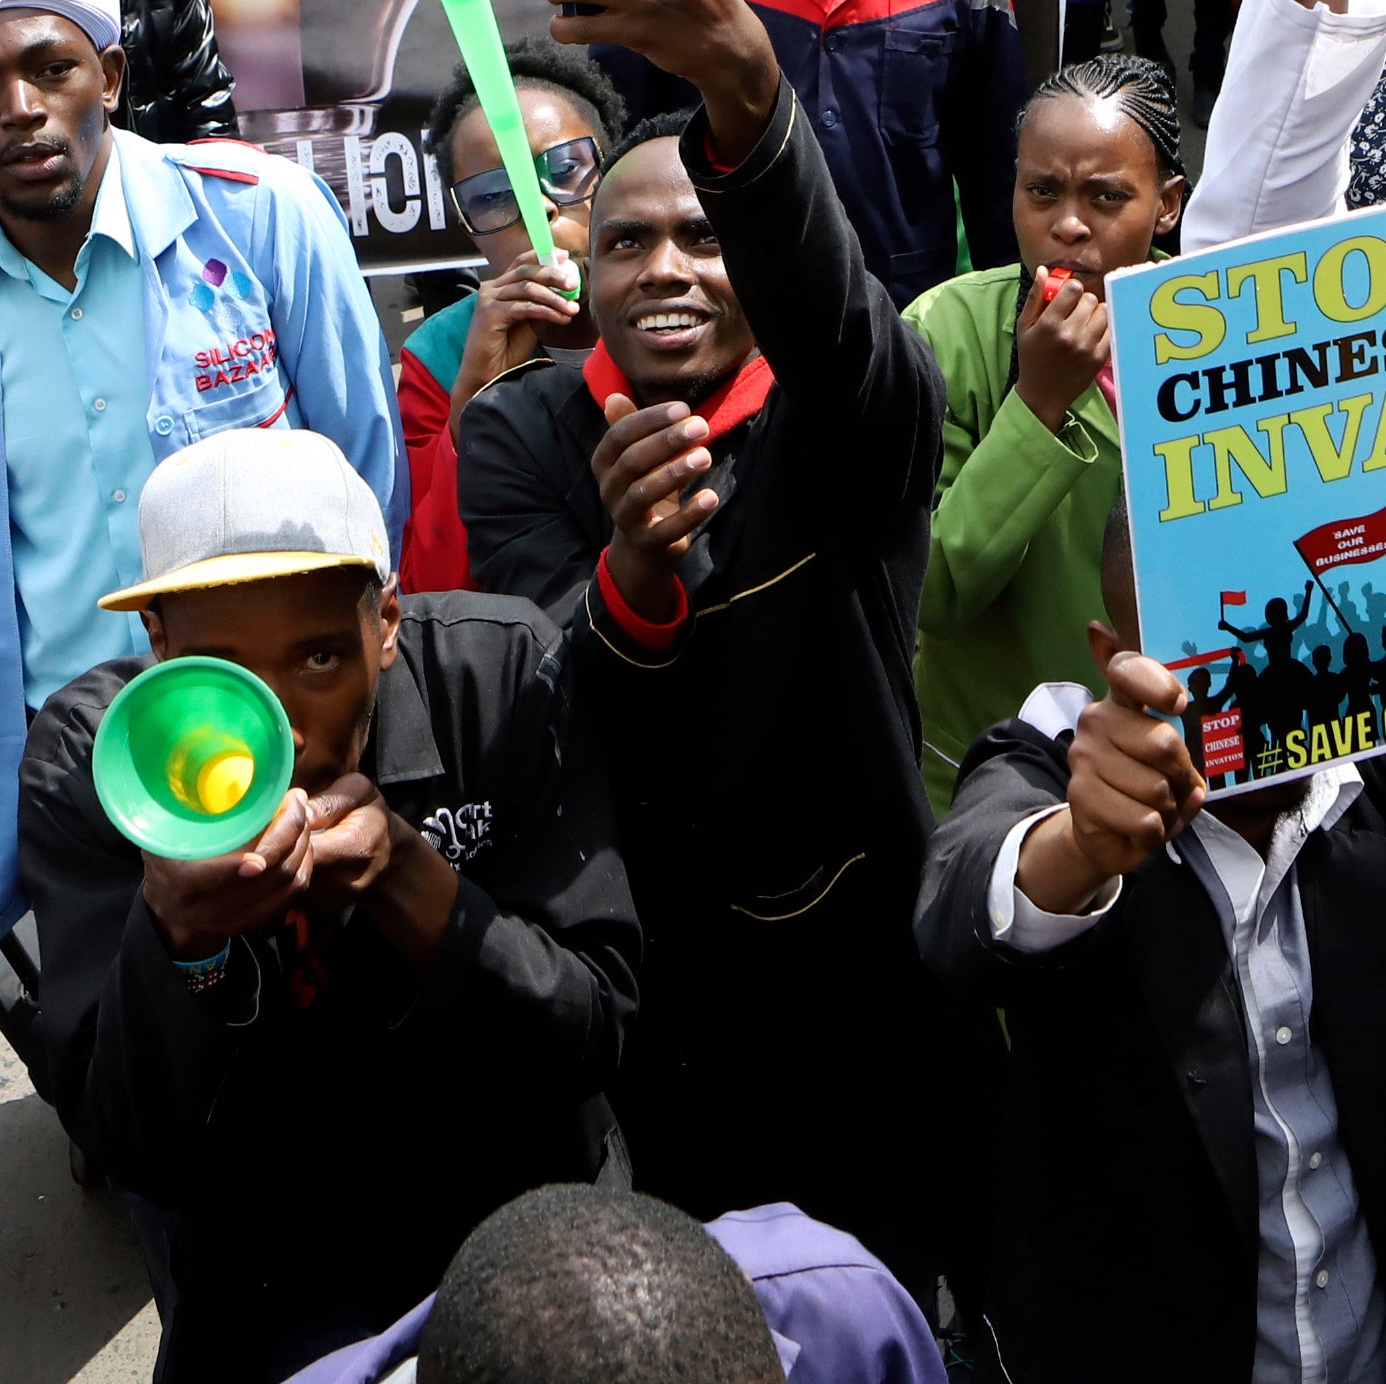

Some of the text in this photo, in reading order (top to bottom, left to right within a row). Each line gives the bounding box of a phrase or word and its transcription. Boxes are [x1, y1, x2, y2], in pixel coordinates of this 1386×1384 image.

[1333, 524, 1366, 540] SAVE
[1336, 536, 1364, 550] OUR
[1202, 714, 1241, 733] STOP
[1204, 735, 1241, 754] CHINESE
[1256, 711, 1374, 779] #SAVE
